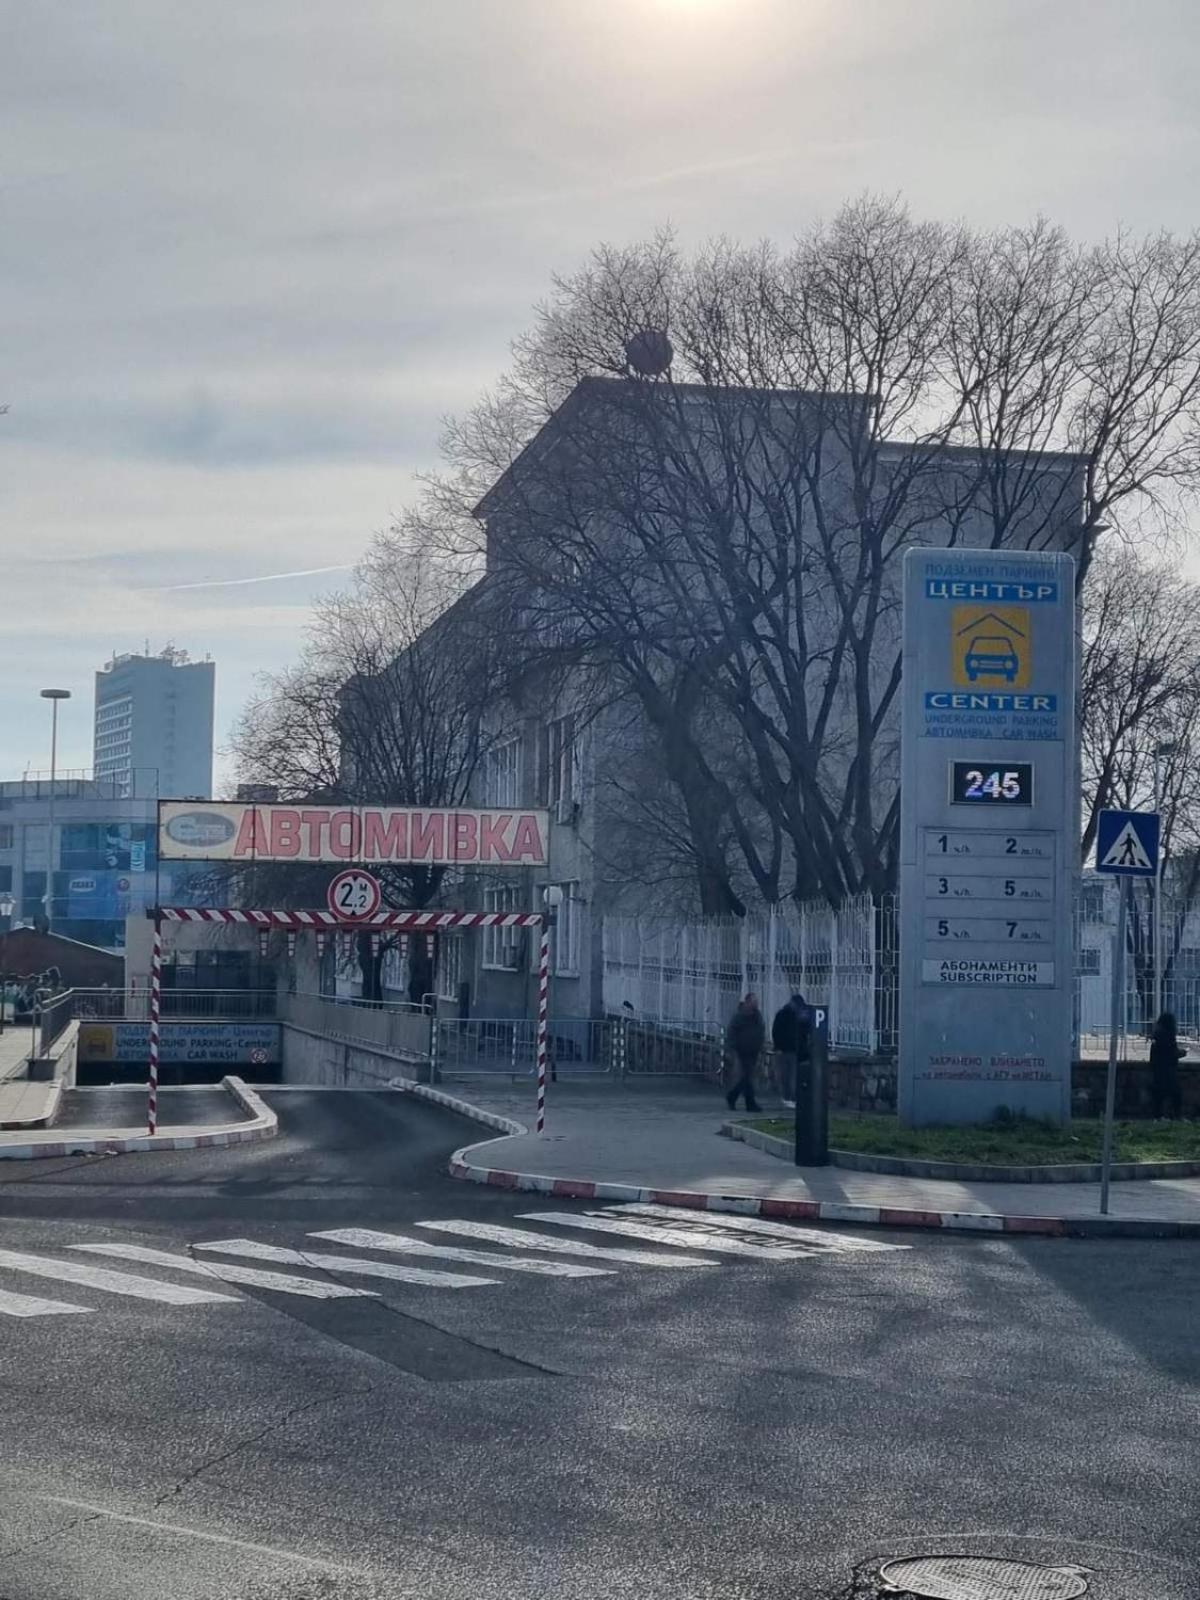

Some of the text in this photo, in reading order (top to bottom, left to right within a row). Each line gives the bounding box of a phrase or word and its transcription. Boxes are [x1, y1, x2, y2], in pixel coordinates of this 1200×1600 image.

[929, 582, 1053, 598] ЦЕНТЪР
[930, 694, 1051, 710] CENTER
[924, 713, 1057, 727] UNDERGROUND PARKING
[924, 727, 993, 738] АВТОМИВКА
[1002, 729, 1057, 740] CAR WASH
[965, 771, 1020, 799] 245
[234, 808, 545, 862] АВТОМИВКА
[937, 834, 948, 853] 1
[1005, 837, 1018, 854] 2
[937, 877, 949, 895] 3
[1003, 880, 1016, 897] 5
[937, 919, 949, 937] 5
[1005, 921, 1018, 938] 7
[940, 960, 1038, 973] АБОНАМЕНТИ
[939, 972, 1037, 984] SUBSCRIPTION
[815, 1009, 826, 1028] P
